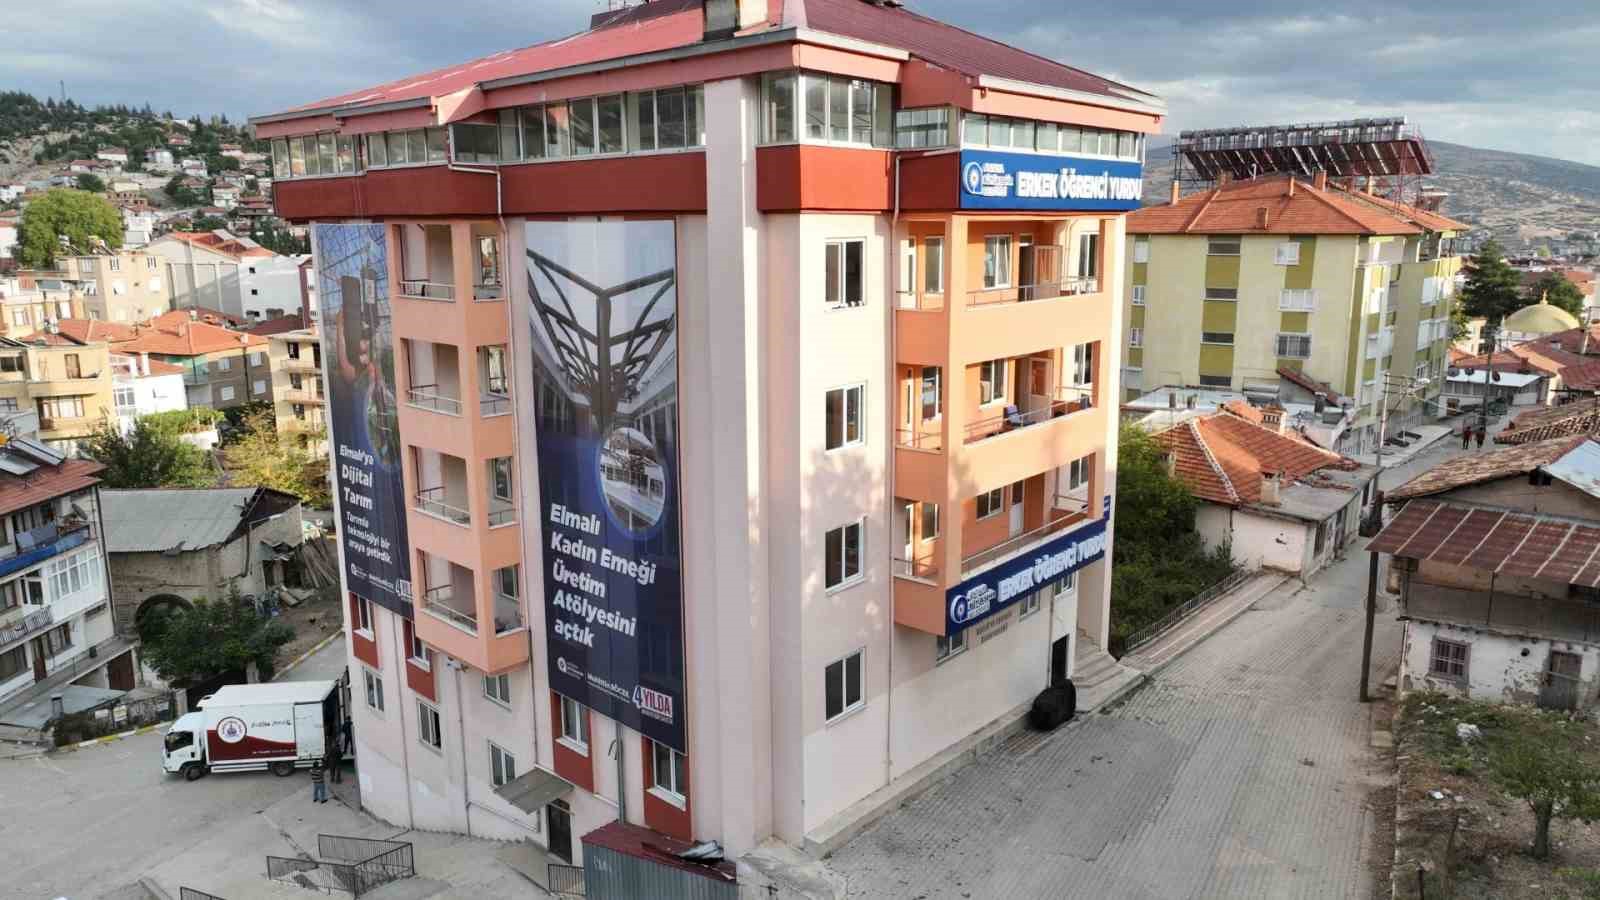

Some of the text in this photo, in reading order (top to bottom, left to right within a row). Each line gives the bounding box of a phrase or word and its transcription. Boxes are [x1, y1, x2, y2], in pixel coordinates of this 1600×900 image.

[1016, 171, 1058, 198] ERKEK
[1059, 168, 1108, 199] ÖĞRENCİ
[1109, 177, 1142, 200] YURDU
[342, 465, 372, 487] Dijital
[344, 488, 372, 510] Tarım
[550, 503, 601, 536] Elmalı
[381, 537, 390, 549] bir
[551, 531, 657, 586] Kadın Emeği
[552, 559, 606, 598] Üretim
[998, 568, 1033, 601] ERKEK
[553, 589, 637, 638] Atölyesini
[554, 617, 596, 648] açtık
[644, 688, 672, 715] YILDA
